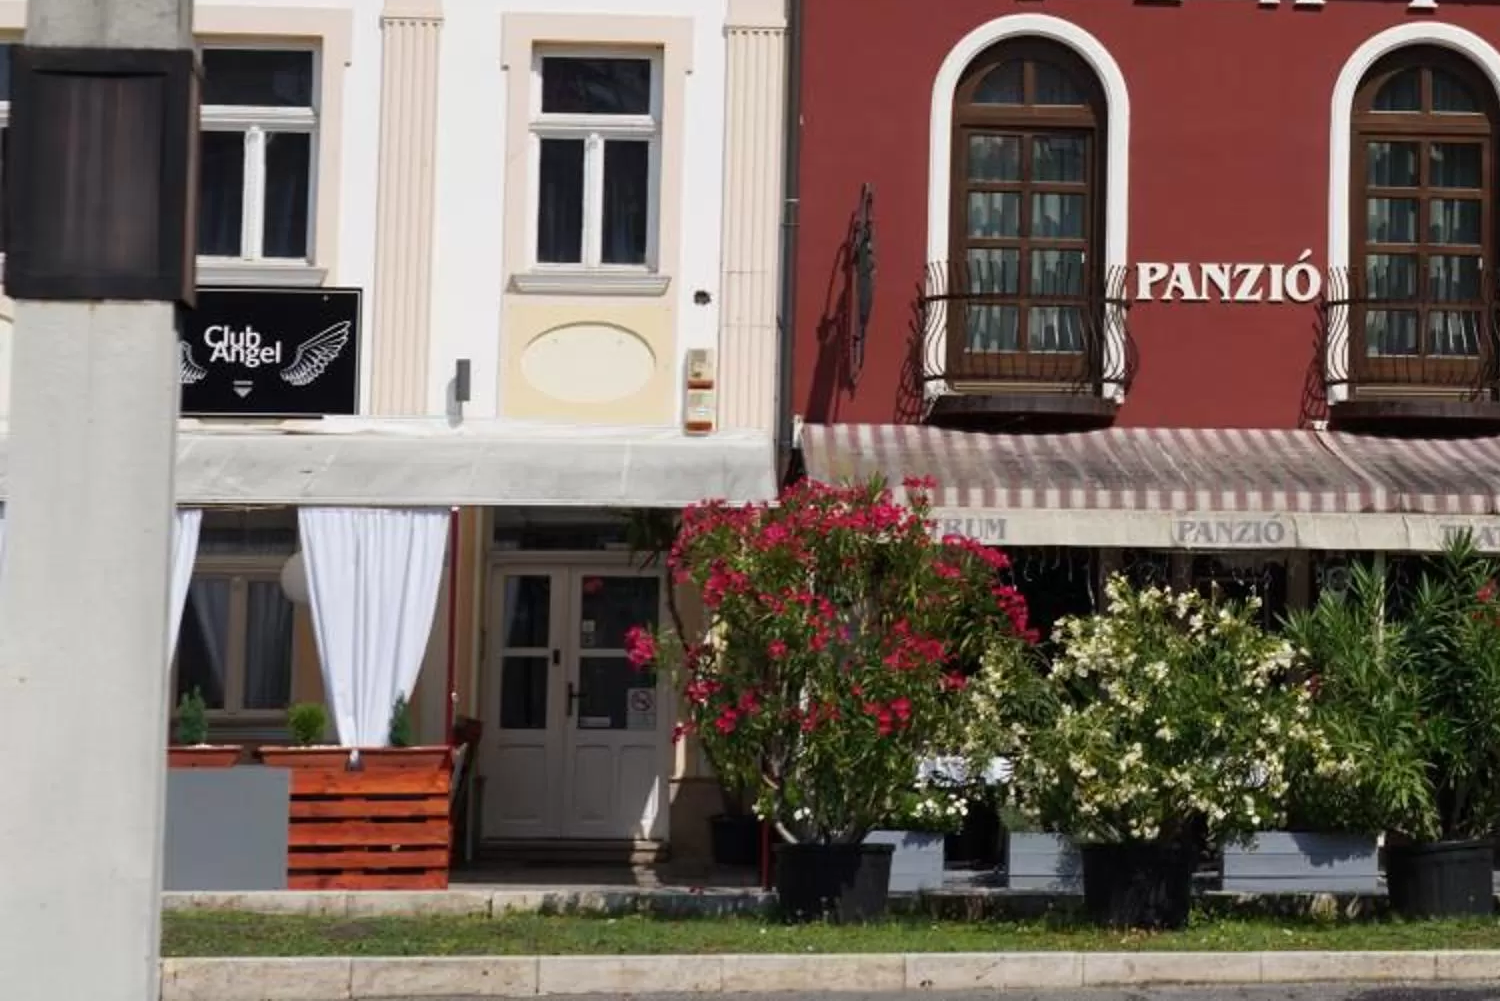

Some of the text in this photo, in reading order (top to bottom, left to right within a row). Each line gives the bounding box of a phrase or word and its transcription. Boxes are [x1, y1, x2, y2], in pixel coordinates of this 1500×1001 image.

[1136, 248, 1322, 302] PANZIÓ
[204, 325, 261, 348] Club
[210, 340, 282, 368] Angel
[1178, 514, 1285, 544] PANZIÓ
